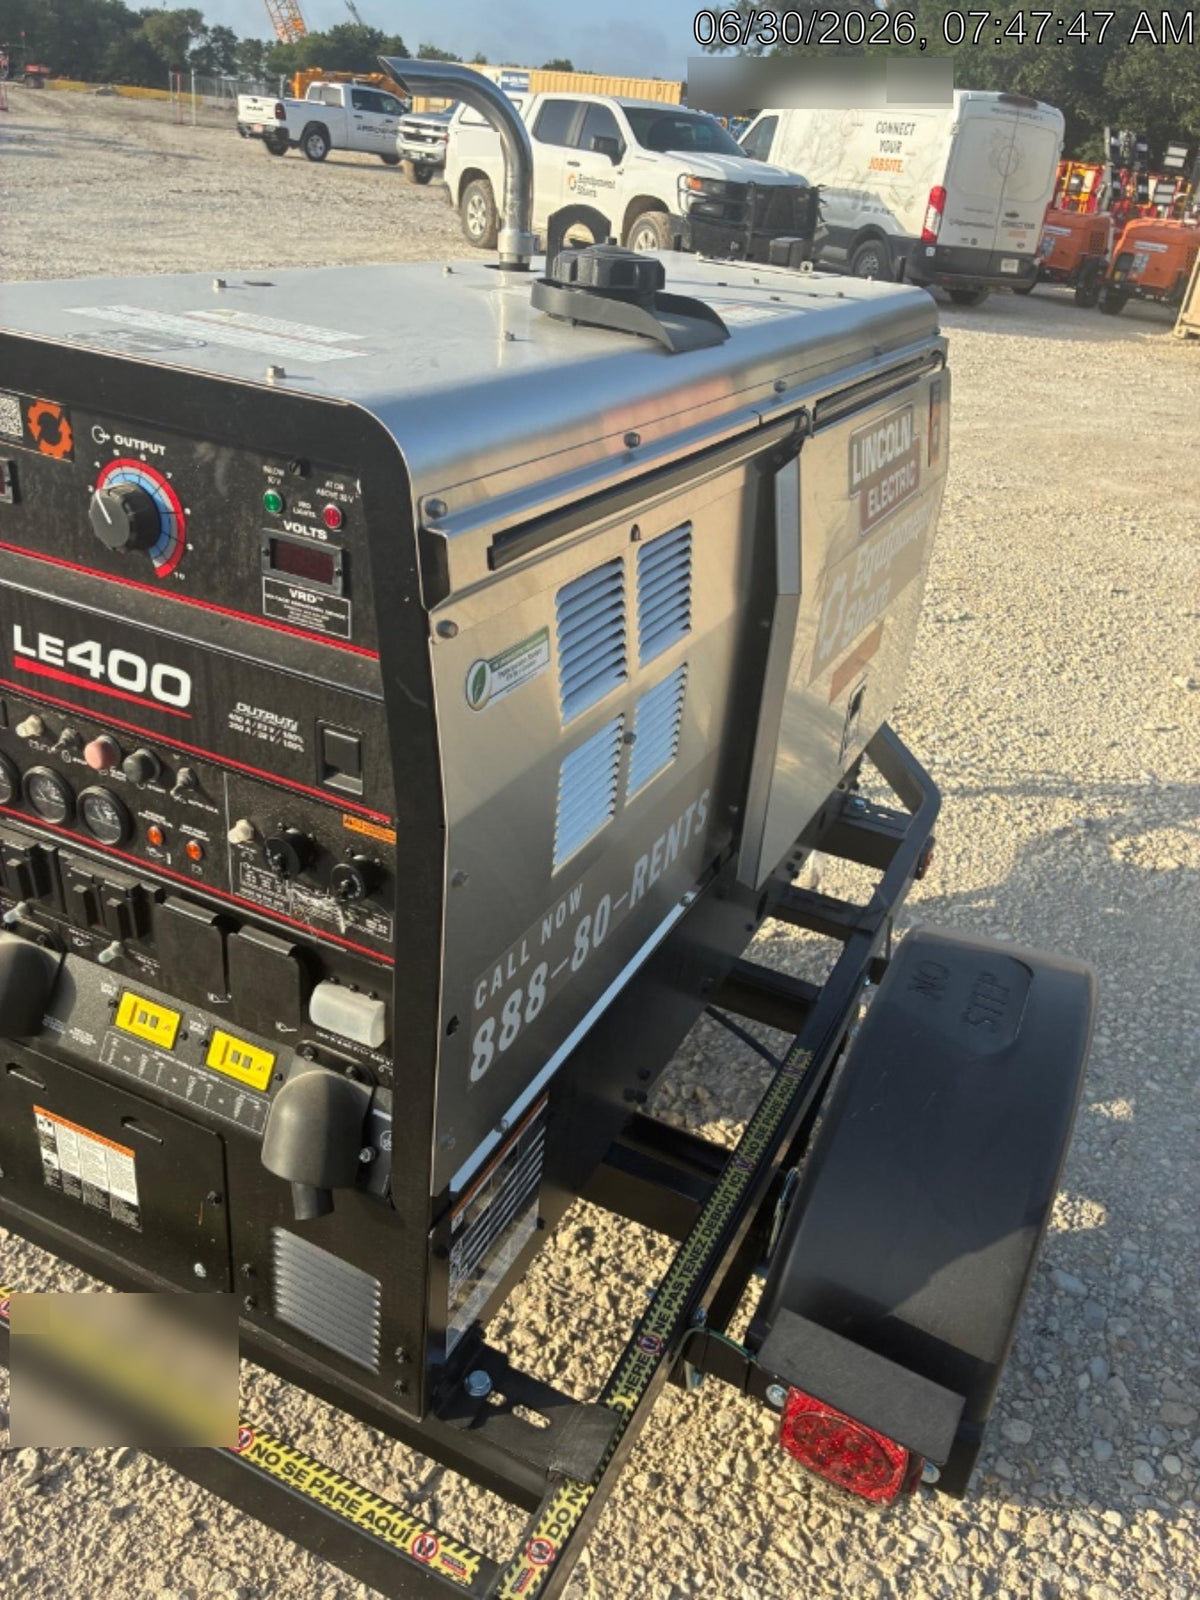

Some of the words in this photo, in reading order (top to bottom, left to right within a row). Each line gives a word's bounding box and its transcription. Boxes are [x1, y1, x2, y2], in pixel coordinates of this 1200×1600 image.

[875, 121, 917, 136] CONNECT
[879, 140, 902, 153] YOUR
[113, 434, 167, 456] OUTPUT
[853, 413, 912, 485] LINCOLN
[867, 460, 916, 519] ELECTRIC
[283, 520, 328, 540] VOLTS
[13, 624, 192, 708] LE400
[470, 789, 710, 1082] 888-80-RENTS
[474, 940, 530, 1010] CALL
[541, 883, 583, 945] NOW
[907, 960, 951, 1001] NO
[652, 1312, 671, 1335] NE
[664, 1280, 686, 1311] PAS
[678, 1238, 706, 1280] TENEZ
[701, 1189, 734, 1239] DEBOUT
[730, 1170, 744, 1188] ICI
[623, 1352, 650, 1397] HERE
[250, 1443, 281, 1466] NO
[281, 1461, 310, 1484] SE
[309, 1477, 363, 1514] PARE
[361, 1509, 414, 1544] AQUÍ
[546, 1507, 571, 1540] DO
[566, 1482, 589, 1506] NO
